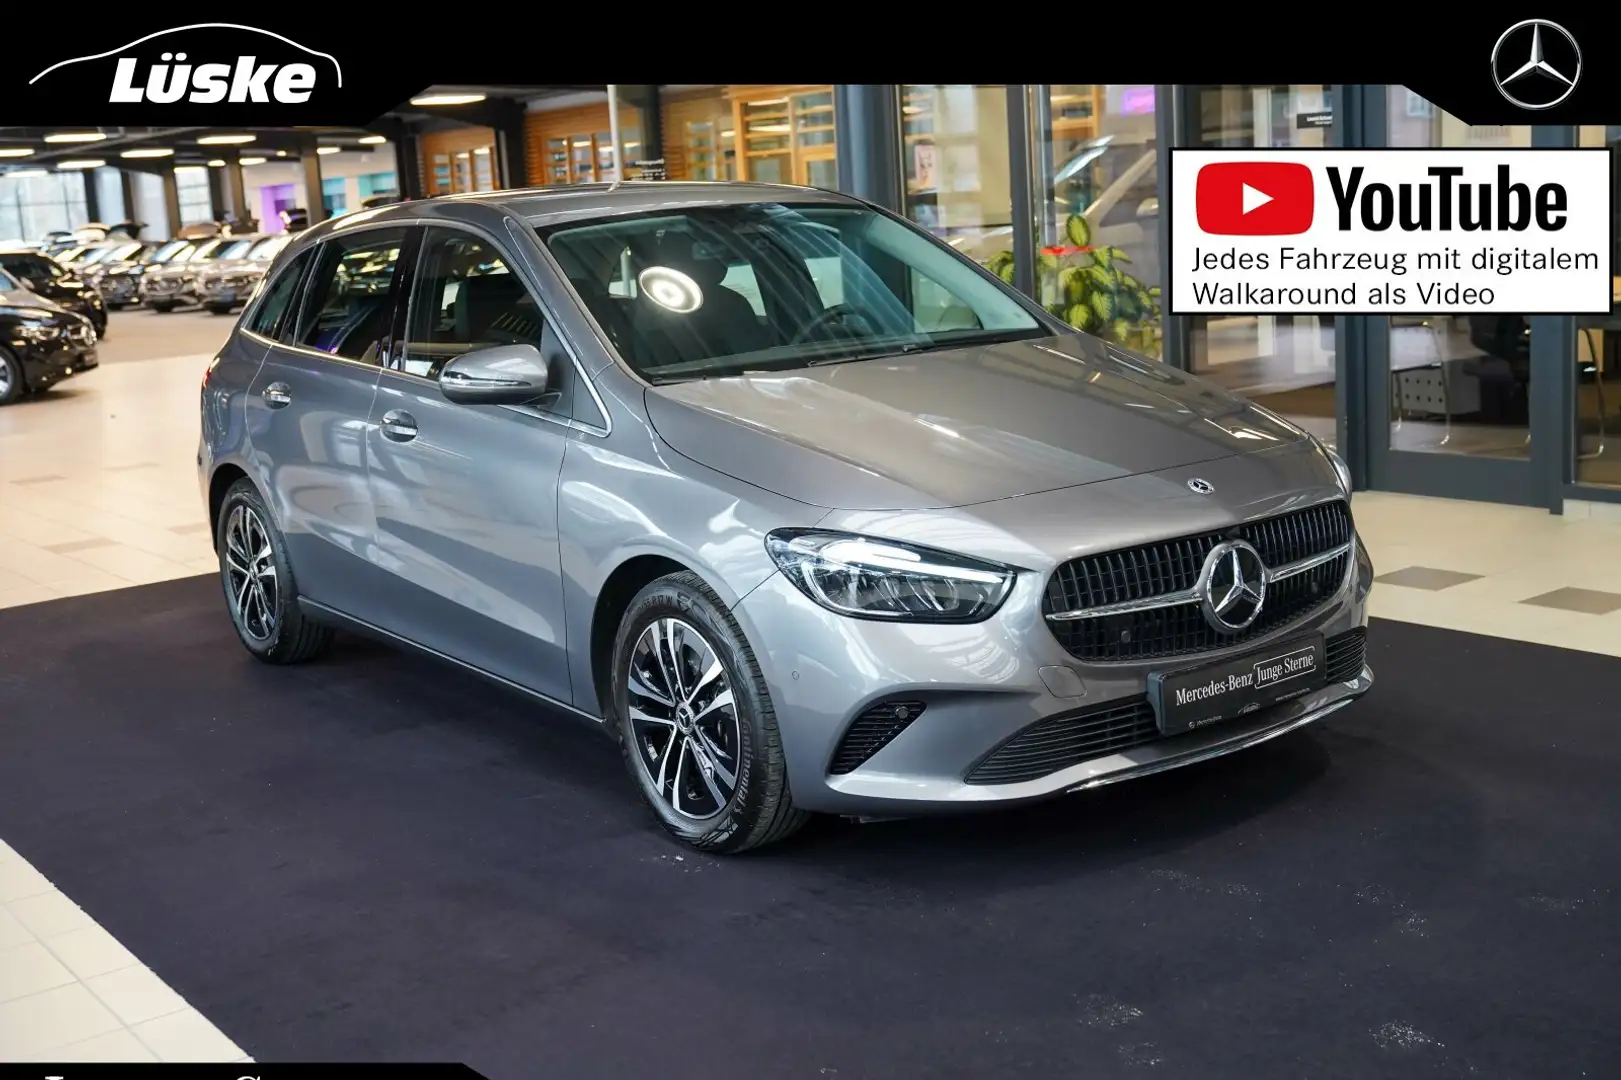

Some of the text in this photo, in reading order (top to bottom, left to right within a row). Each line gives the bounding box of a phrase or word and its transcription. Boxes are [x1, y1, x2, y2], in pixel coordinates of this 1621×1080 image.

[1175, 673, 1253, 706] Mercedes-Benz
[1256, 664, 1283, 685] Junge
[1284, 654, 1315, 674] Sterne
